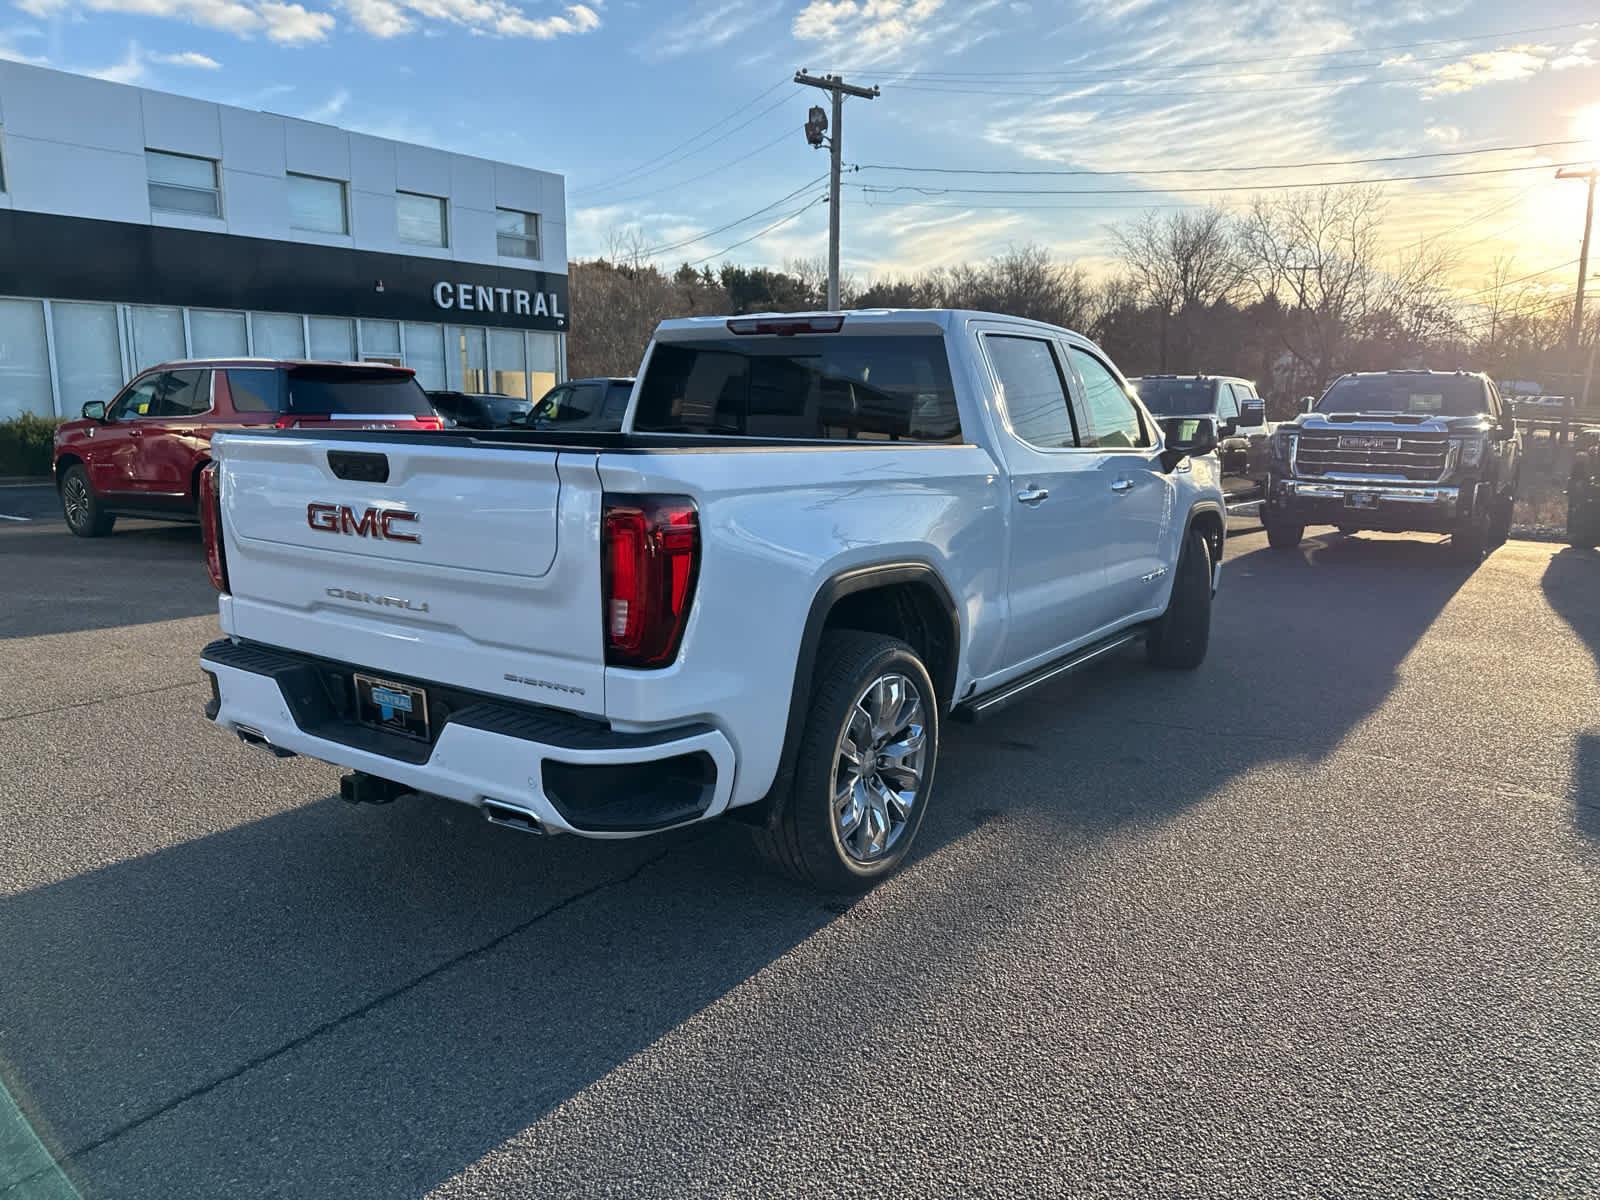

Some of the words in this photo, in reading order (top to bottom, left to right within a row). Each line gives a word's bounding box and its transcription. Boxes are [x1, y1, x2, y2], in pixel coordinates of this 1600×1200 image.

[433, 281, 565, 318] CENTRAL
[307, 503, 421, 544] GMC
[326, 588, 429, 613] DENALI
[503, 673, 586, 695] SIERRA
